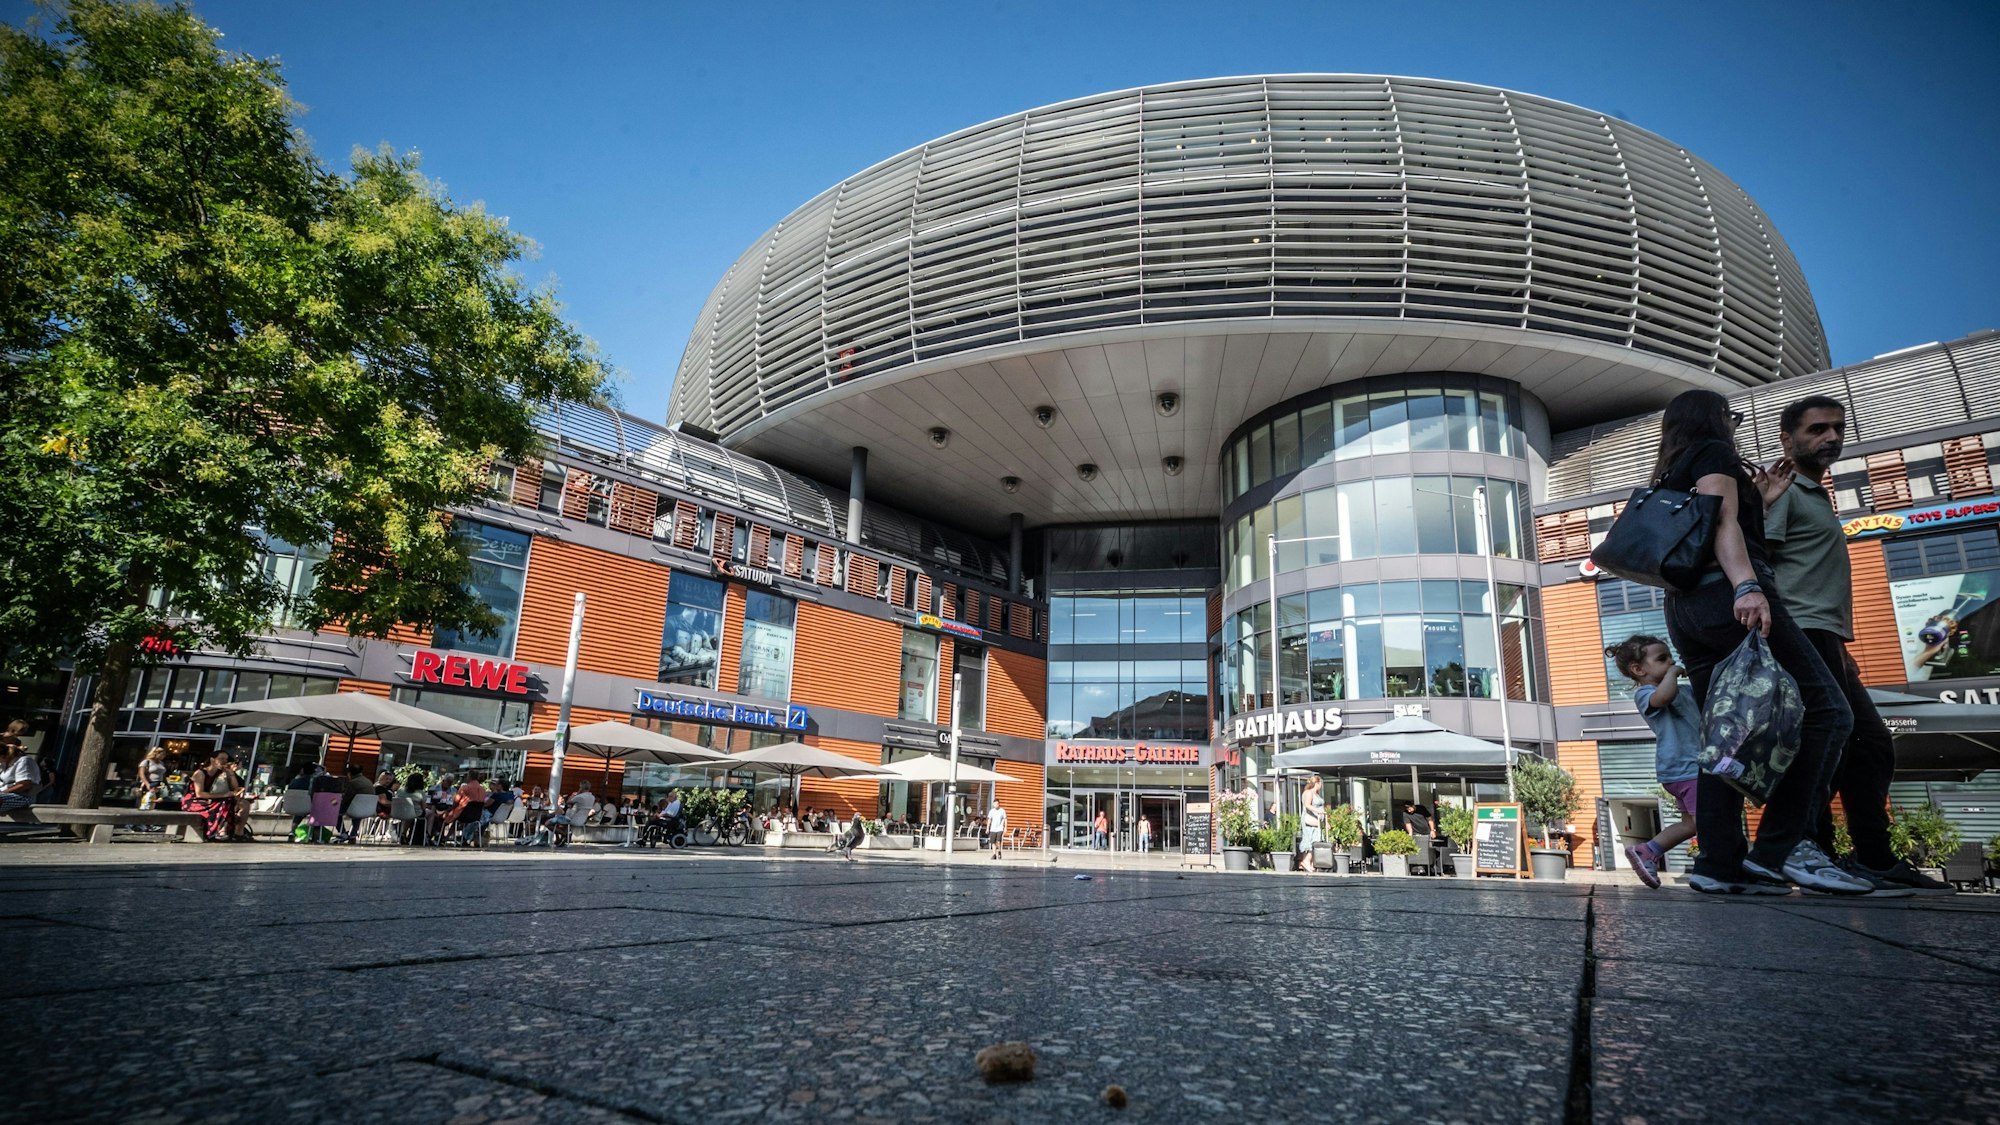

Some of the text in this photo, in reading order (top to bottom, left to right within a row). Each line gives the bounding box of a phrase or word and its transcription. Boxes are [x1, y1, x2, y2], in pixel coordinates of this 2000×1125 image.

[1843, 502, 2000, 534] SMYTHS TOYS SUPERS
[735, 564, 773, 585] SATURN
[411, 651, 528, 694] REWE
[637, 691, 776, 727] Deutsche Bank
[1235, 707, 1343, 740] RATHAUS
[1379, 751, 1401, 759] Brasserie
